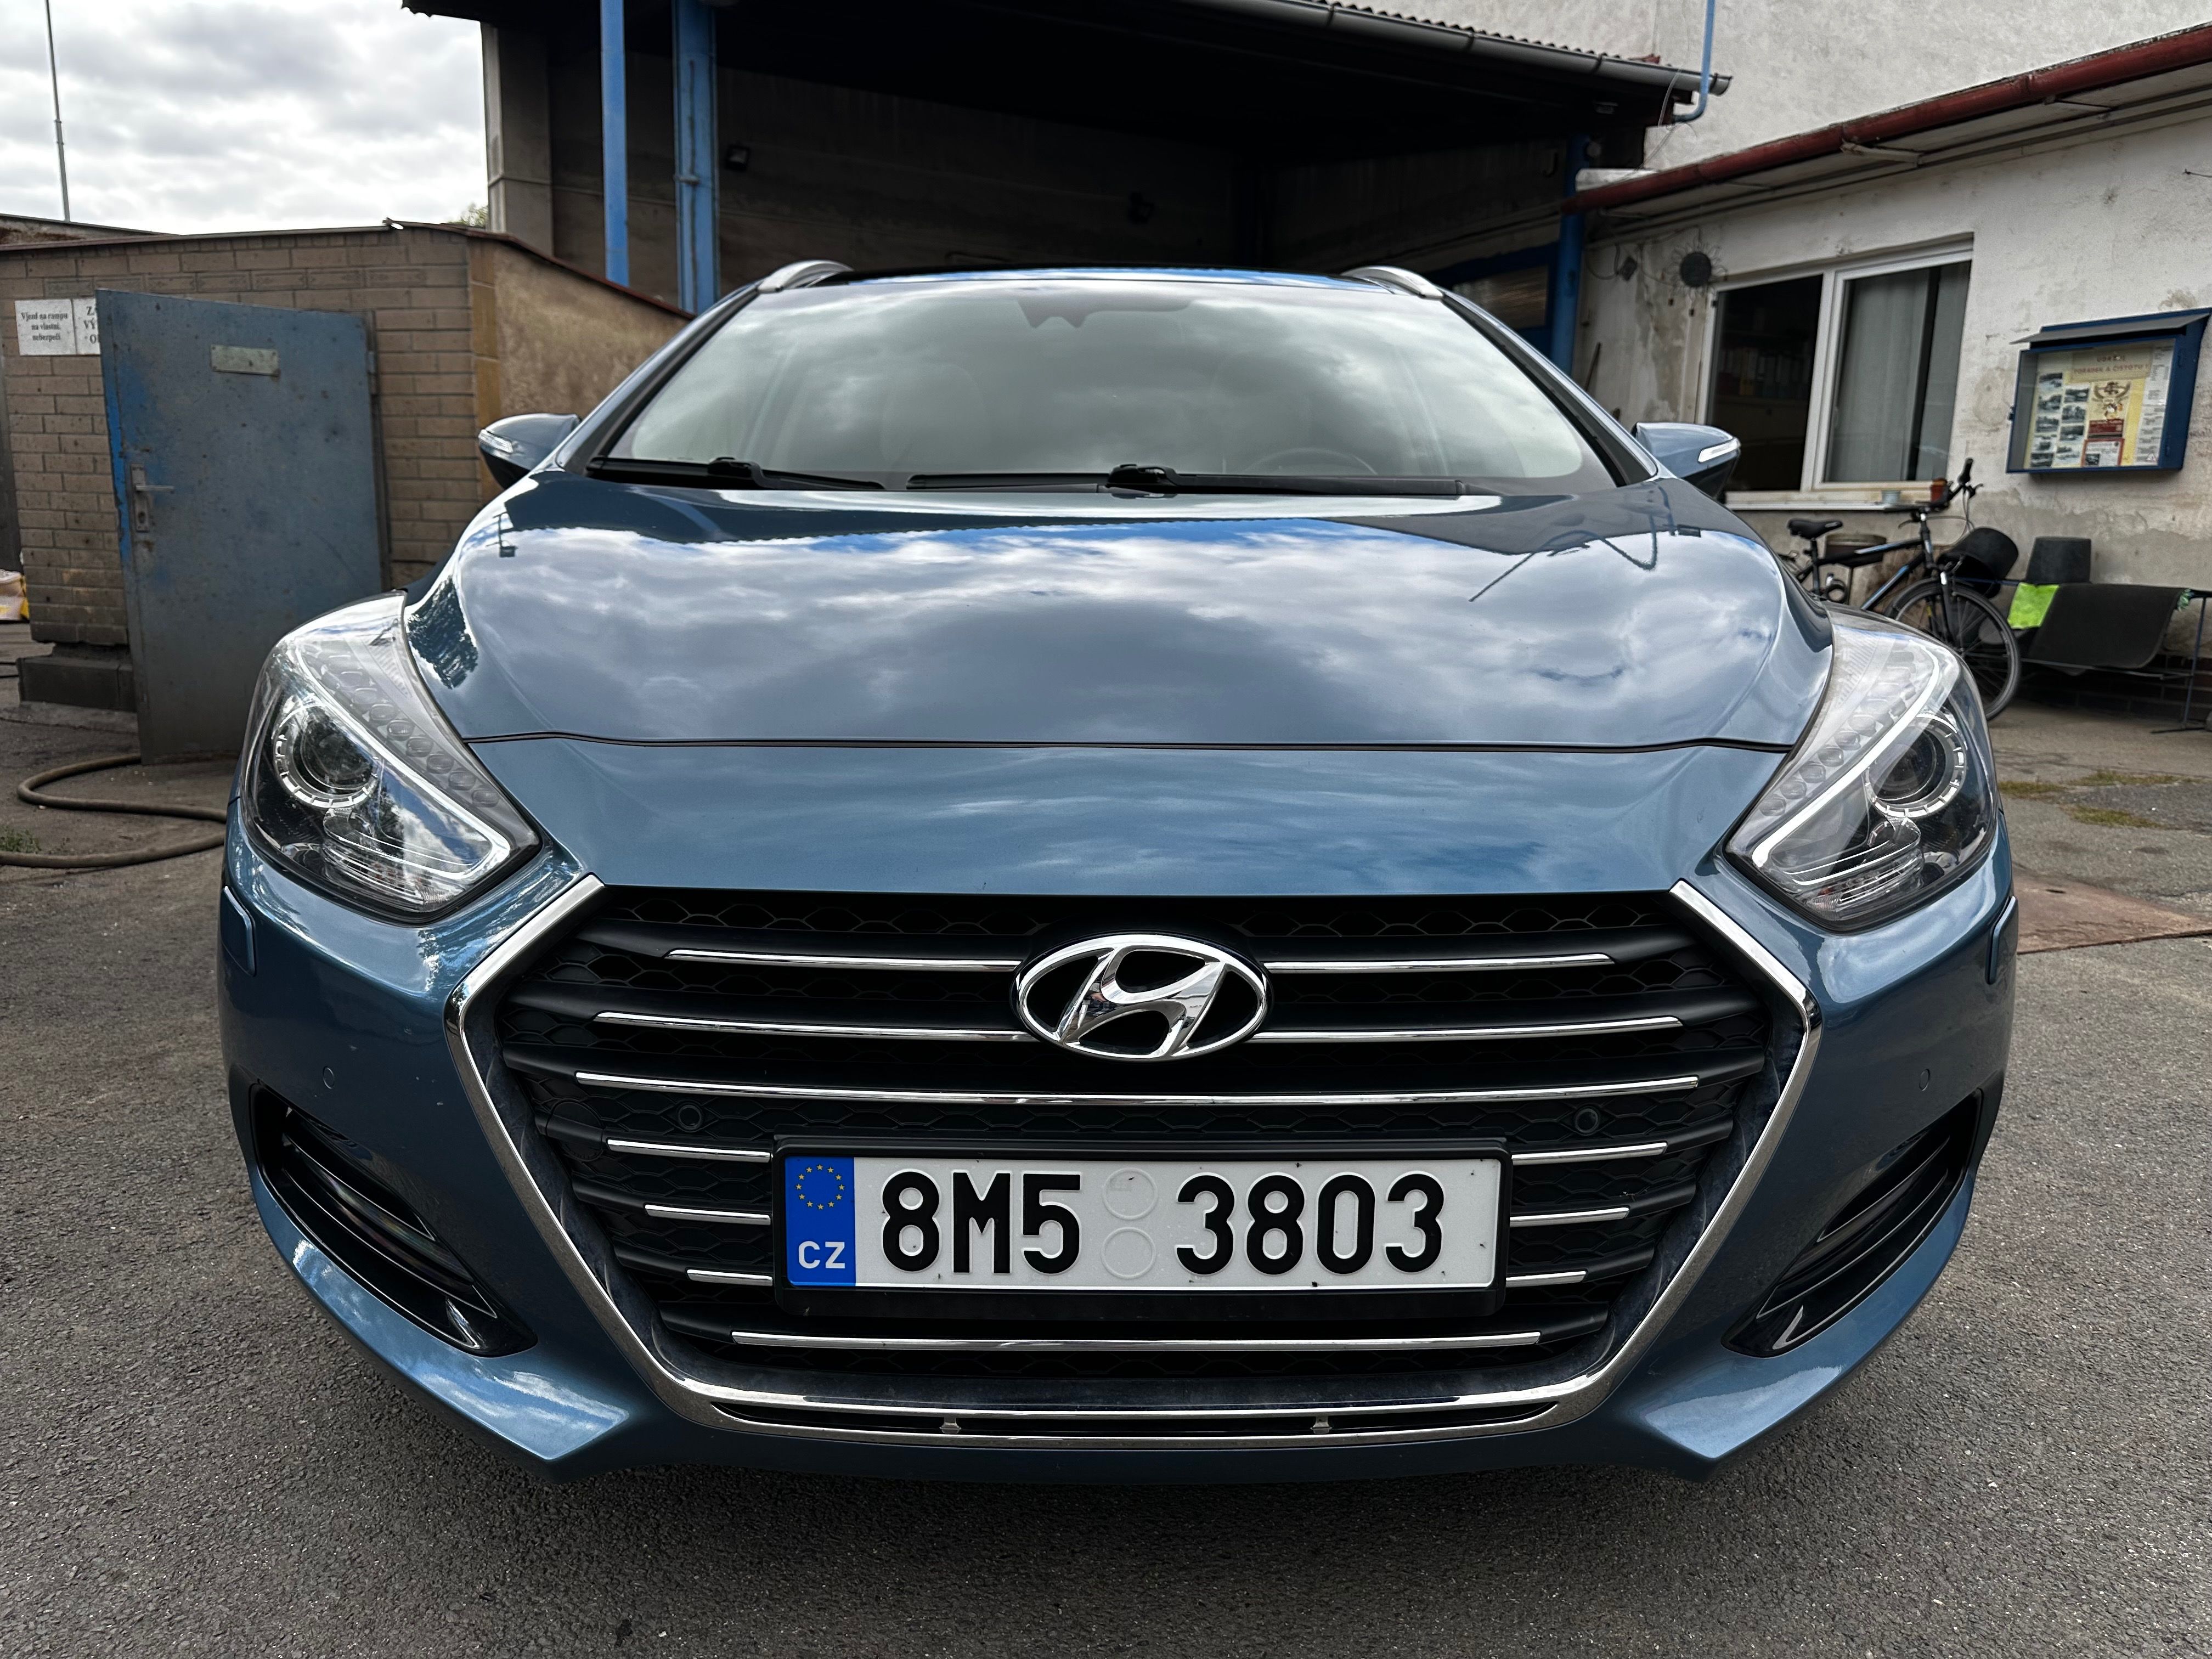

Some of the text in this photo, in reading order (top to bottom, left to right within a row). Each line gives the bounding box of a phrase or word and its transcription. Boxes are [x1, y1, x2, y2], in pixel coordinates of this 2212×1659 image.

[21, 311, 38, 322] Vjezd
[48, 312, 68, 321] rampu
[882, 1171, 1444, 1274] 8M5 3803
[798, 1241, 845, 1269] CZ
